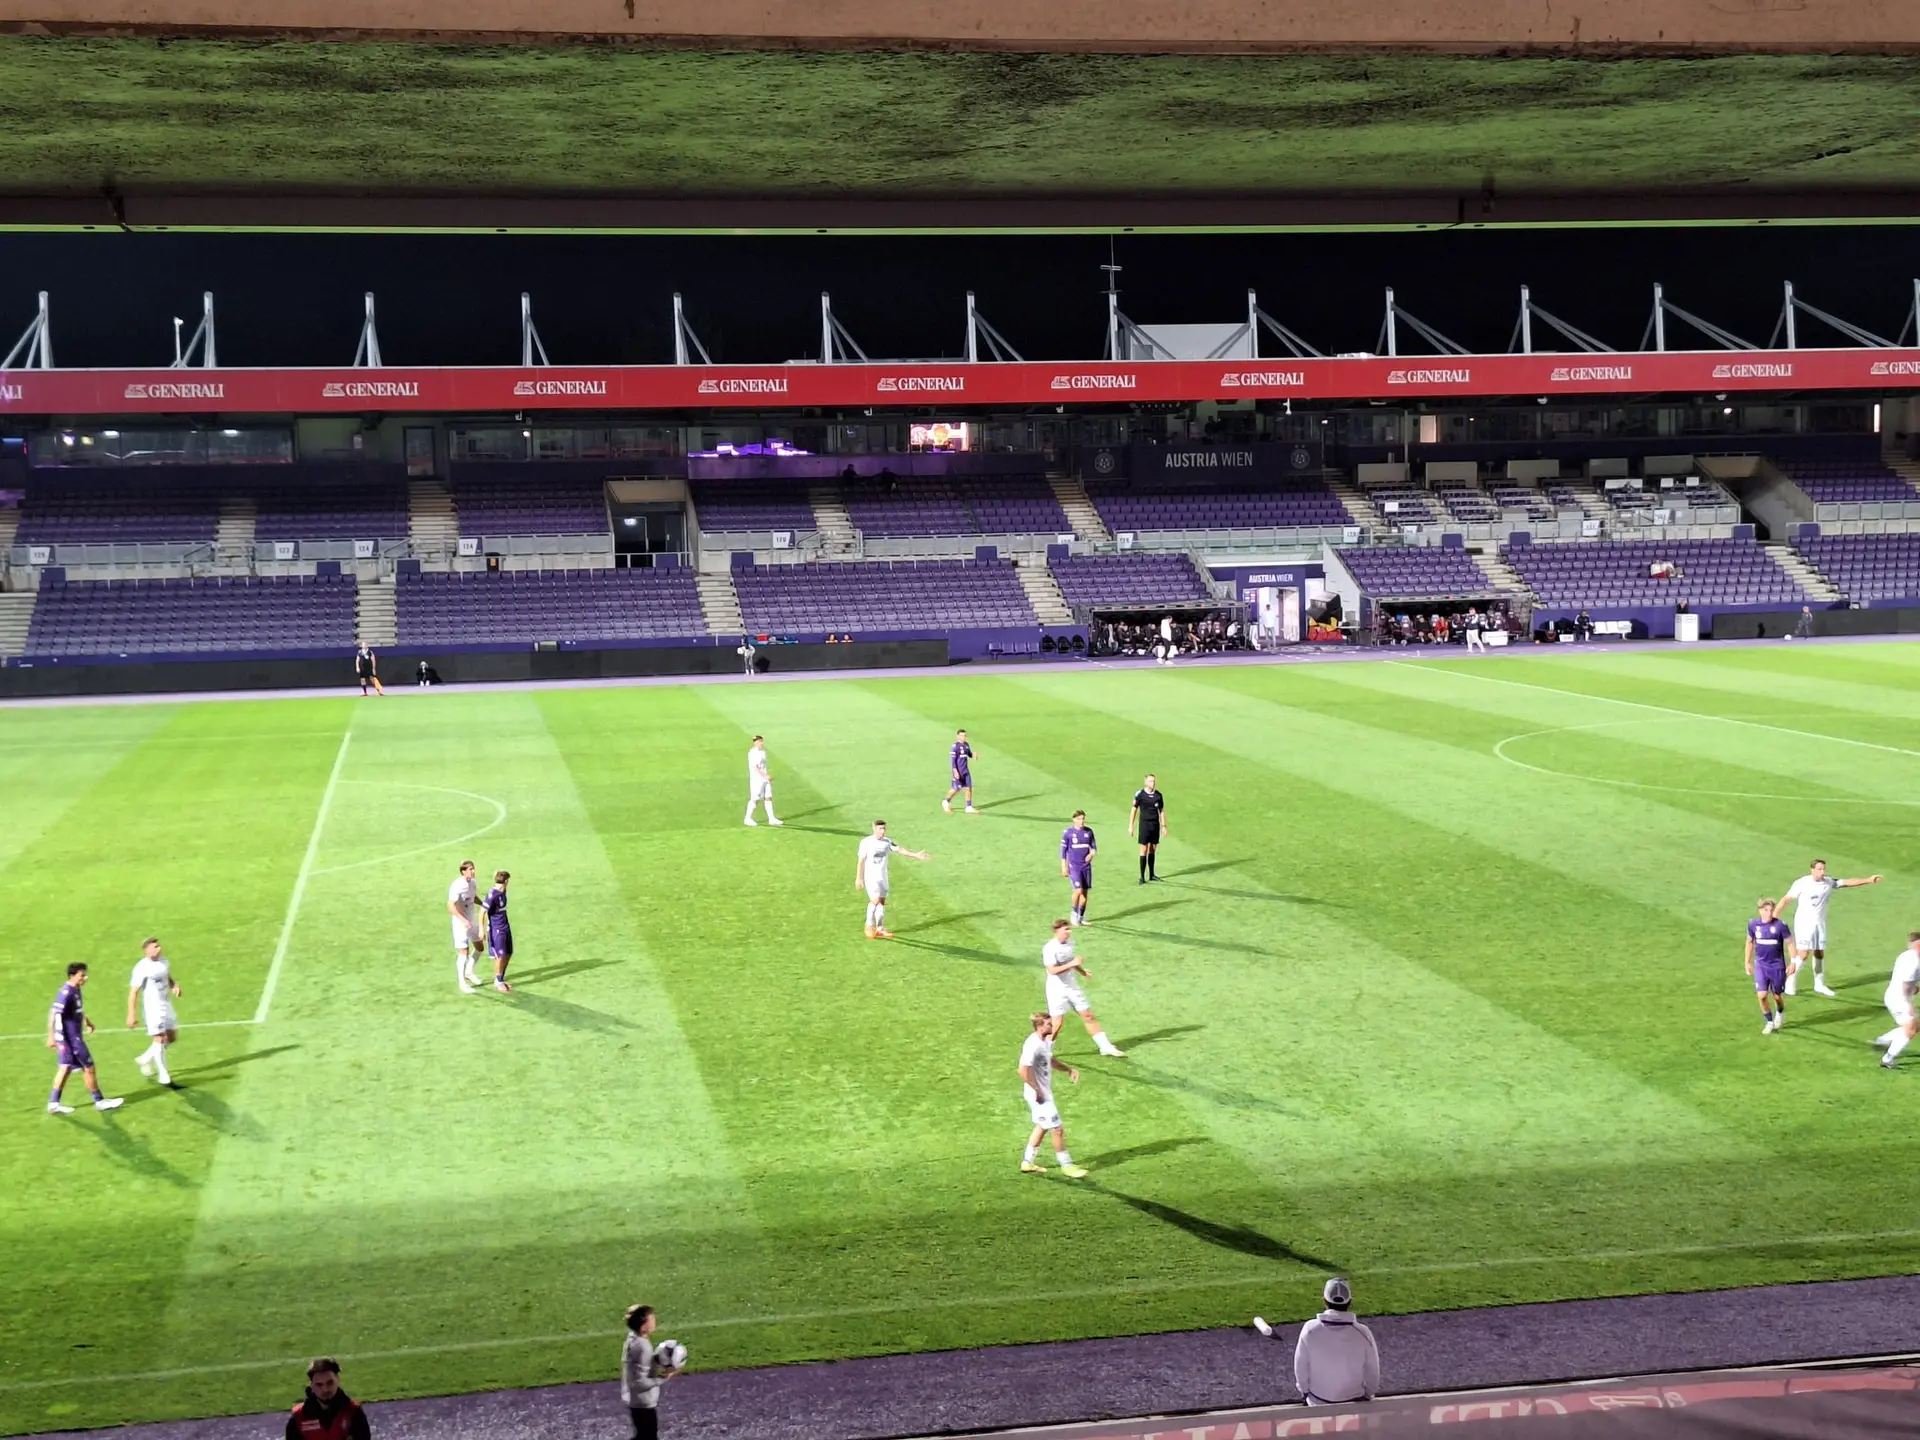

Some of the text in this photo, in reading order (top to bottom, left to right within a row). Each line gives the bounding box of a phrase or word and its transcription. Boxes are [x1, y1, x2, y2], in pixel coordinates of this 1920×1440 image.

[1241, 372, 1305, 386] GENERALI
[1408, 369, 1470, 384] GENERALI
[1571, 367, 1633, 381] GENERALI
[1732, 364, 1793, 379] GENERALI
[537, 380, 607, 394] GENERALI
[720, 378, 788, 393] GENERALI
[898, 376, 965, 391] GENERALI
[1072, 374, 1137, 389] GENERALI
[149, 383, 225, 398] GENERALI
[346, 382, 419, 397] GENERALI
[1165, 451, 1253, 468] AUSTRIA WIEN
[1248, 573, 1293, 583] AUSTRIA WIEN
